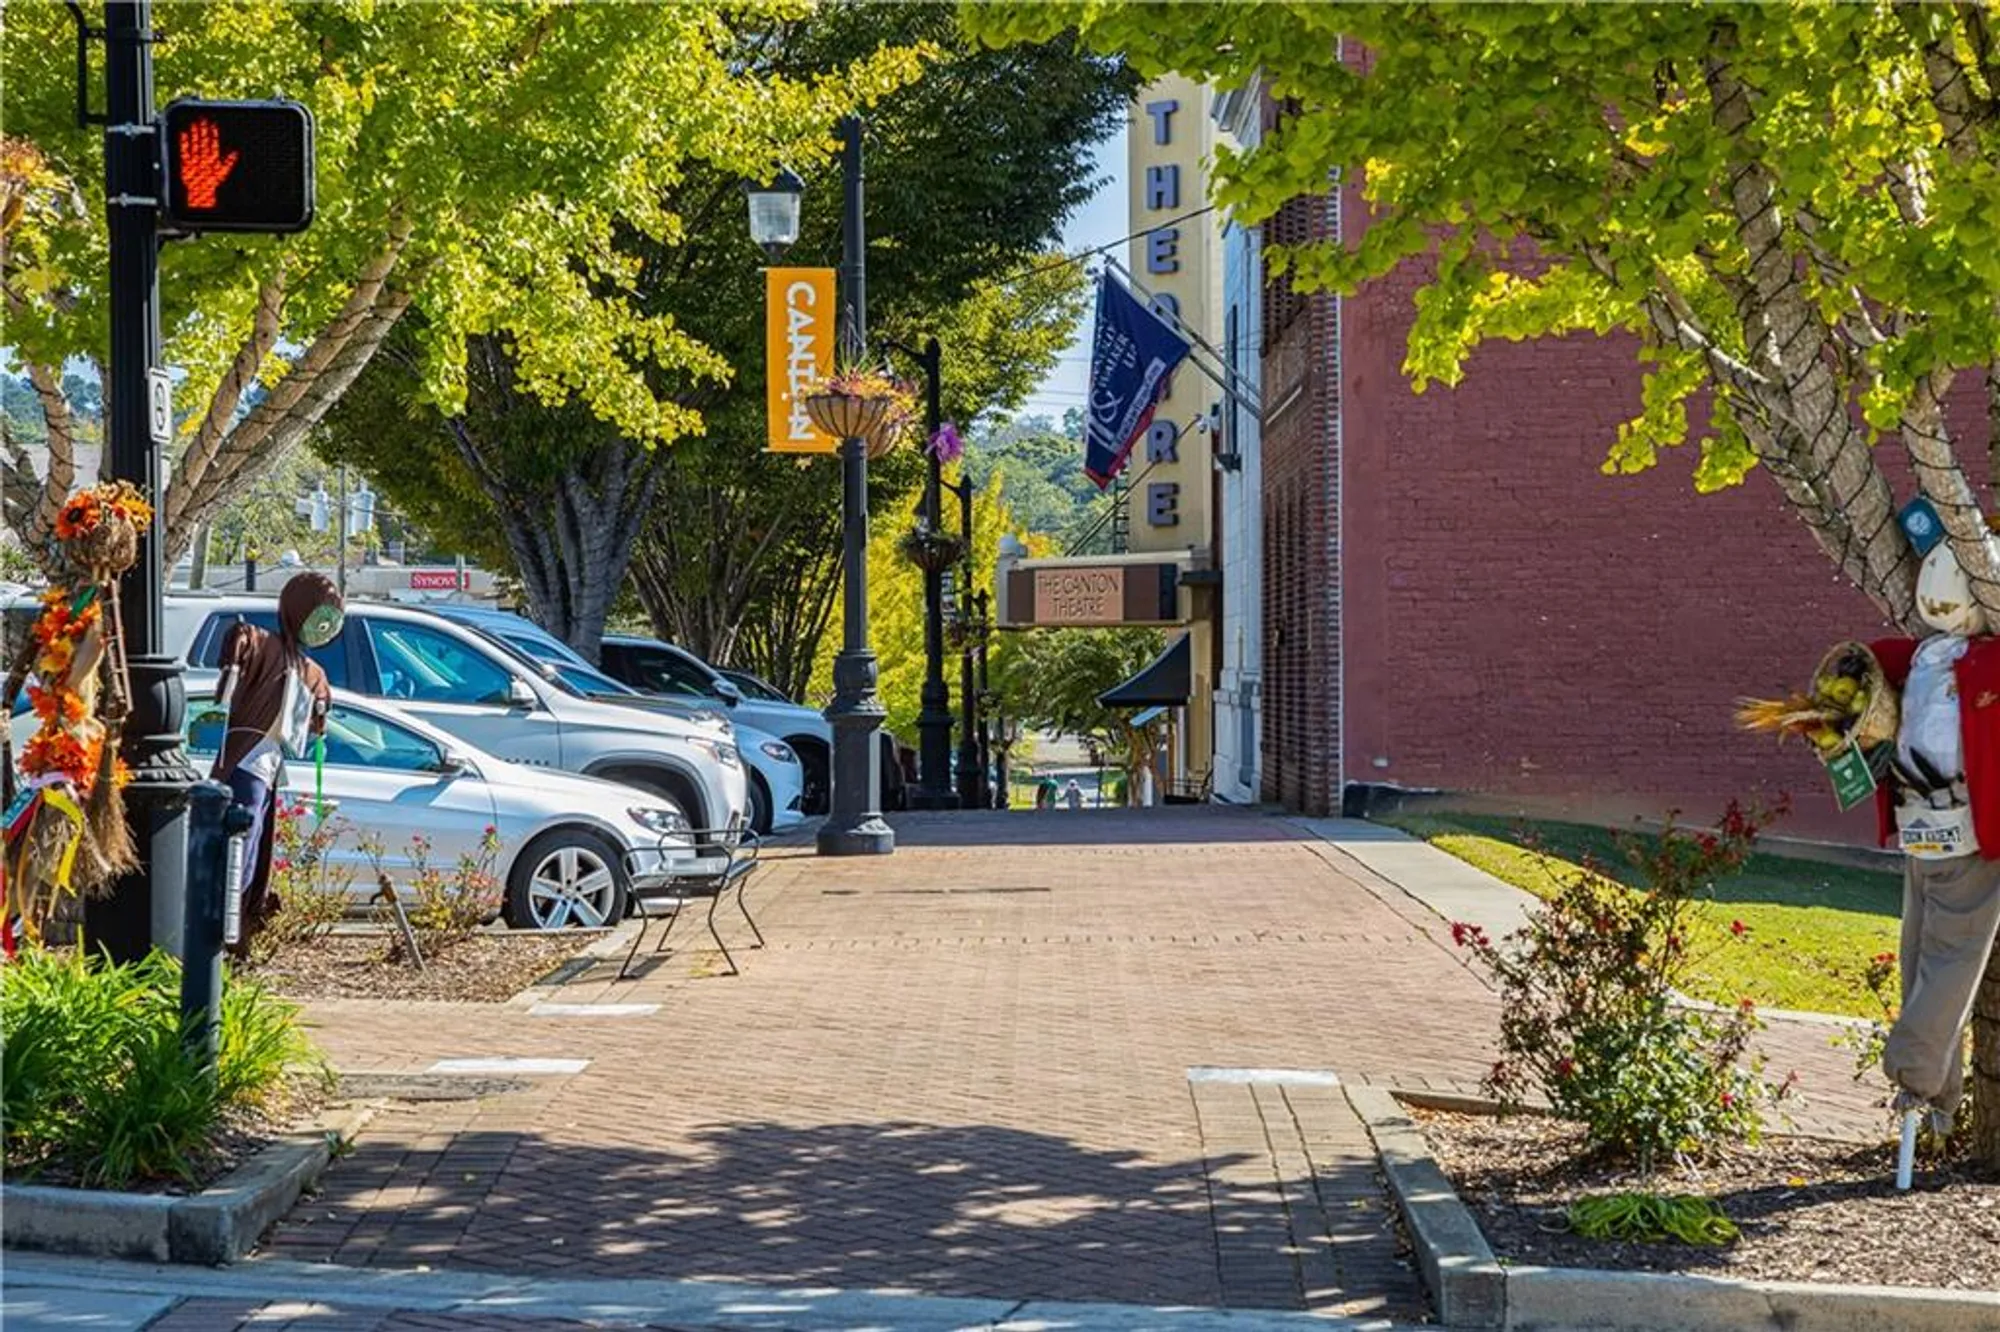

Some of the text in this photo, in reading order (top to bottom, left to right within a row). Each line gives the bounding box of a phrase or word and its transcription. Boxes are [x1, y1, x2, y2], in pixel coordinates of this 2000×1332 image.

[1146, 99, 1180, 527] THEARE
[1038, 573, 1119, 594] THE CANTON
[1053, 597, 1106, 617] THEATRE
